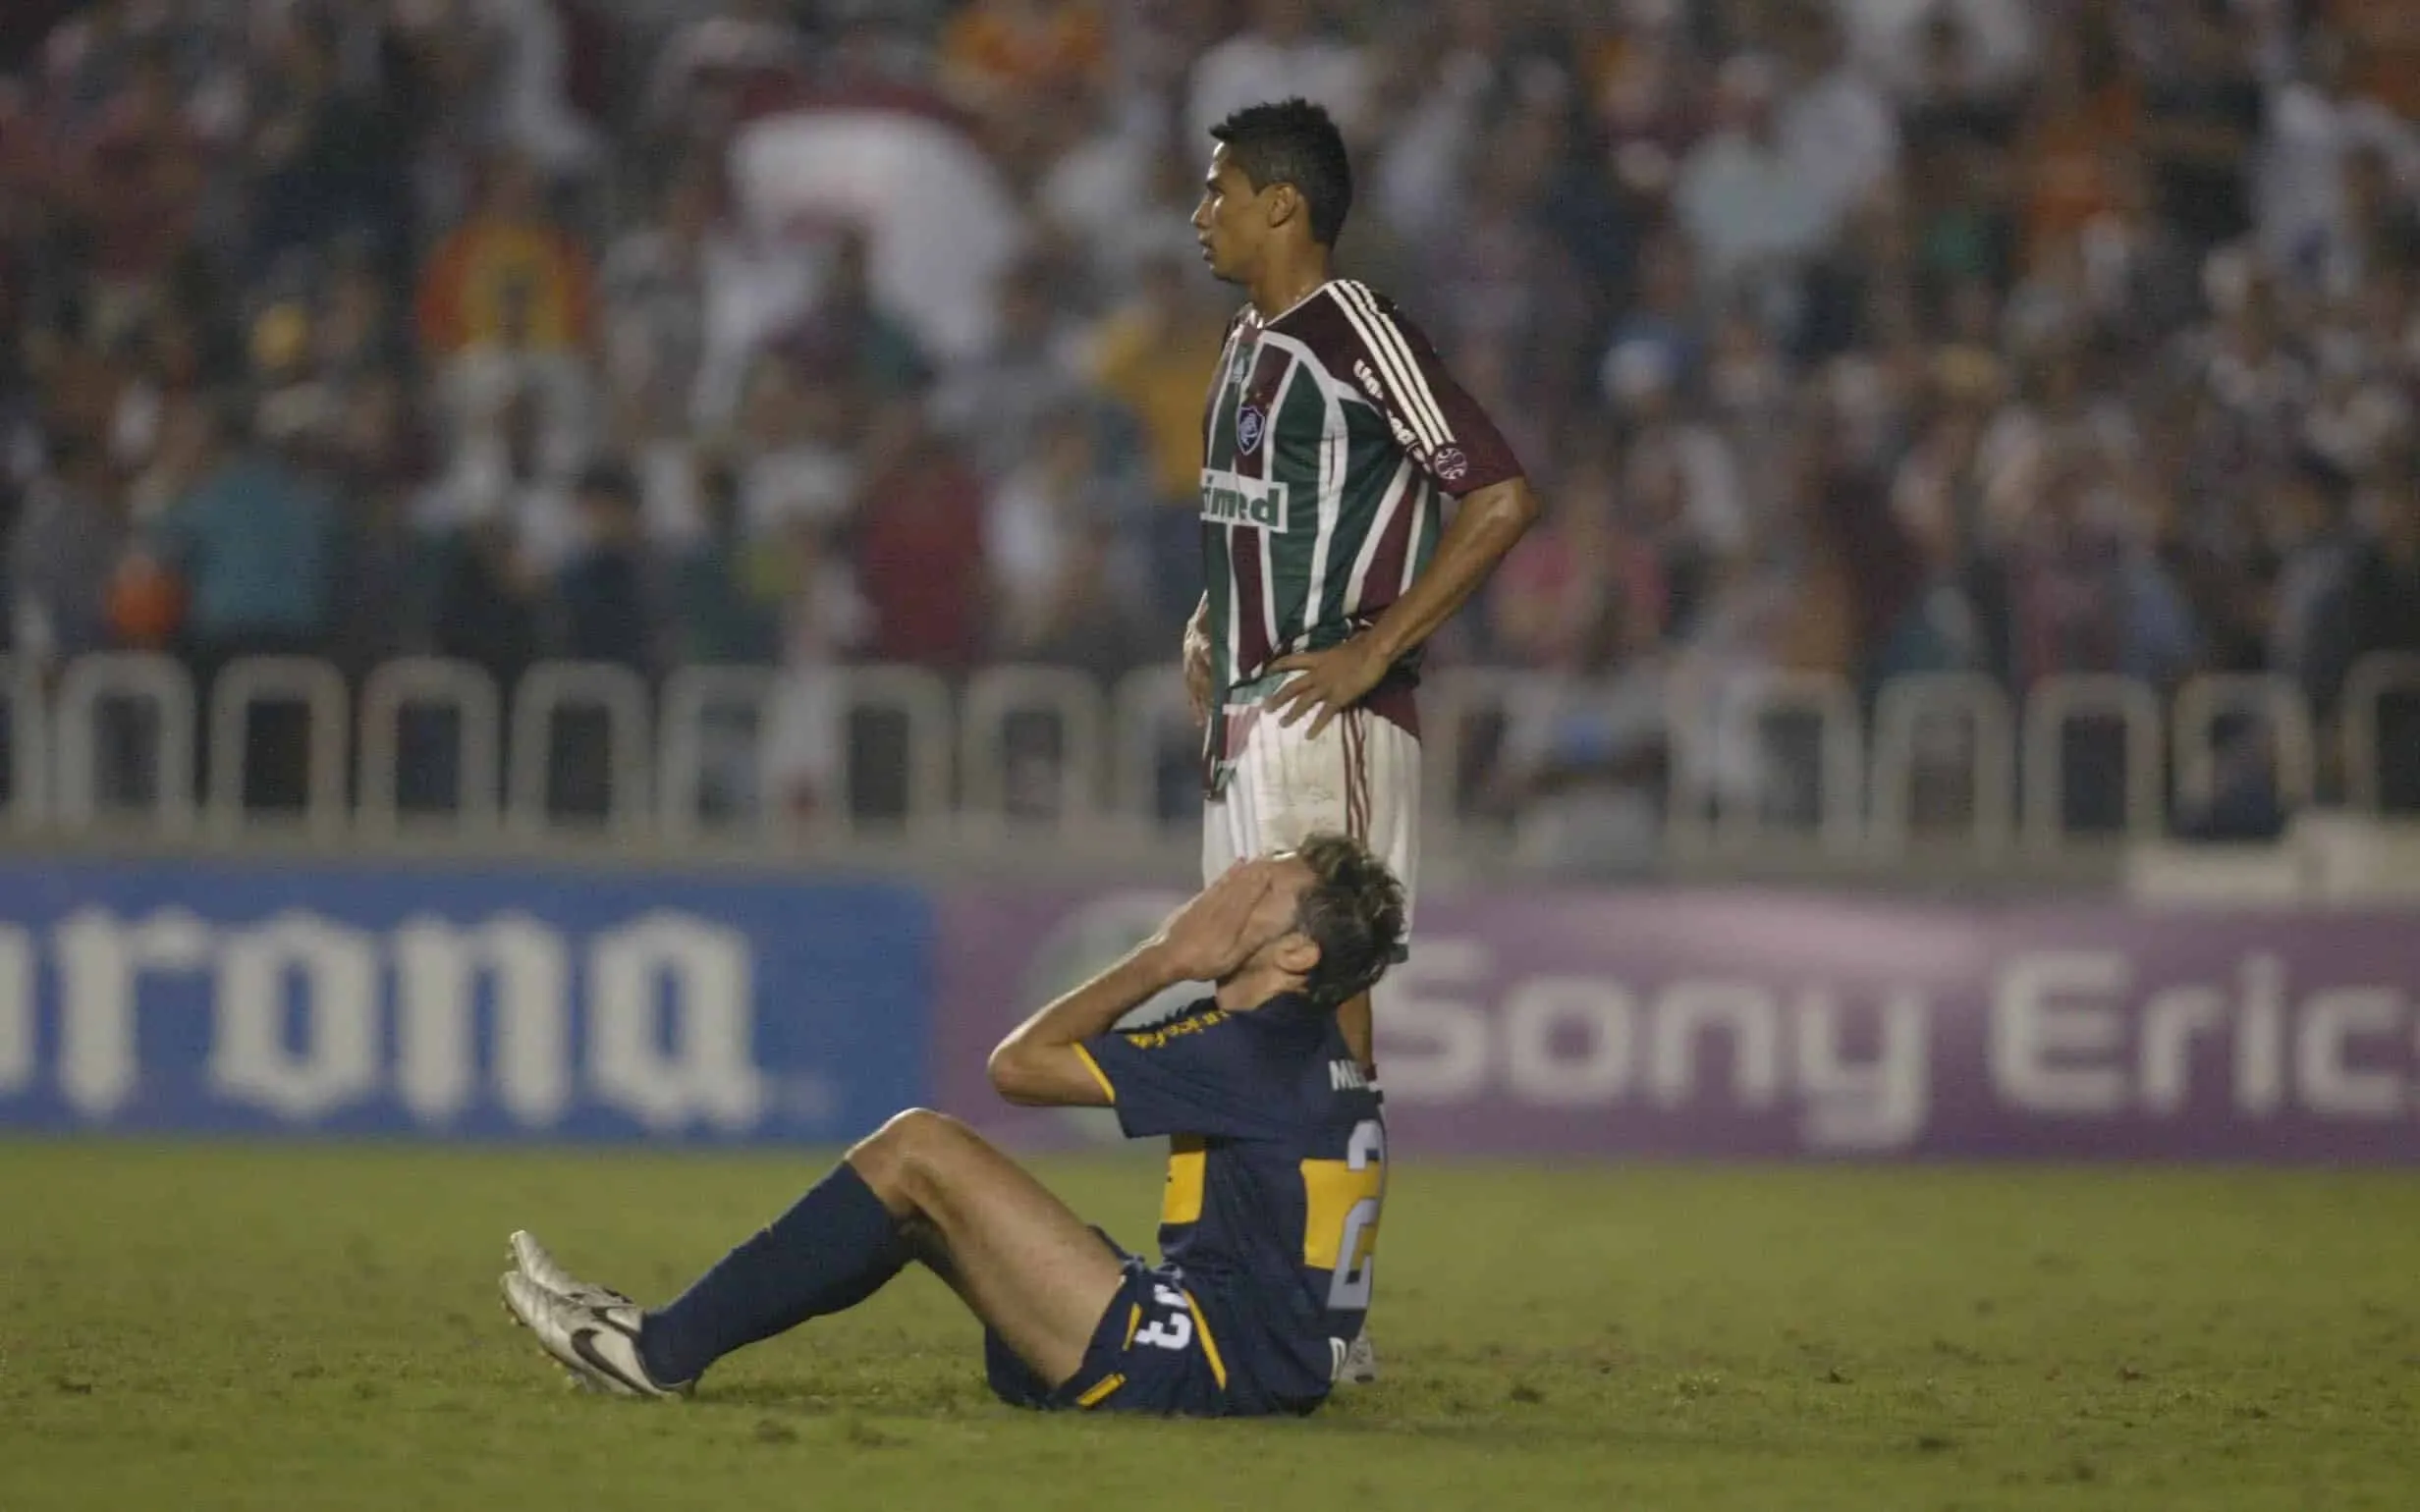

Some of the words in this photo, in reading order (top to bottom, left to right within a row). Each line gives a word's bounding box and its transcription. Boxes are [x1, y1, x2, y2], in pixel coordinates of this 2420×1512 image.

[0, 905, 766, 1130] rona
[1374, 939, 1931, 1148] Sony
[1991, 948, 2420, 1115] Eric
